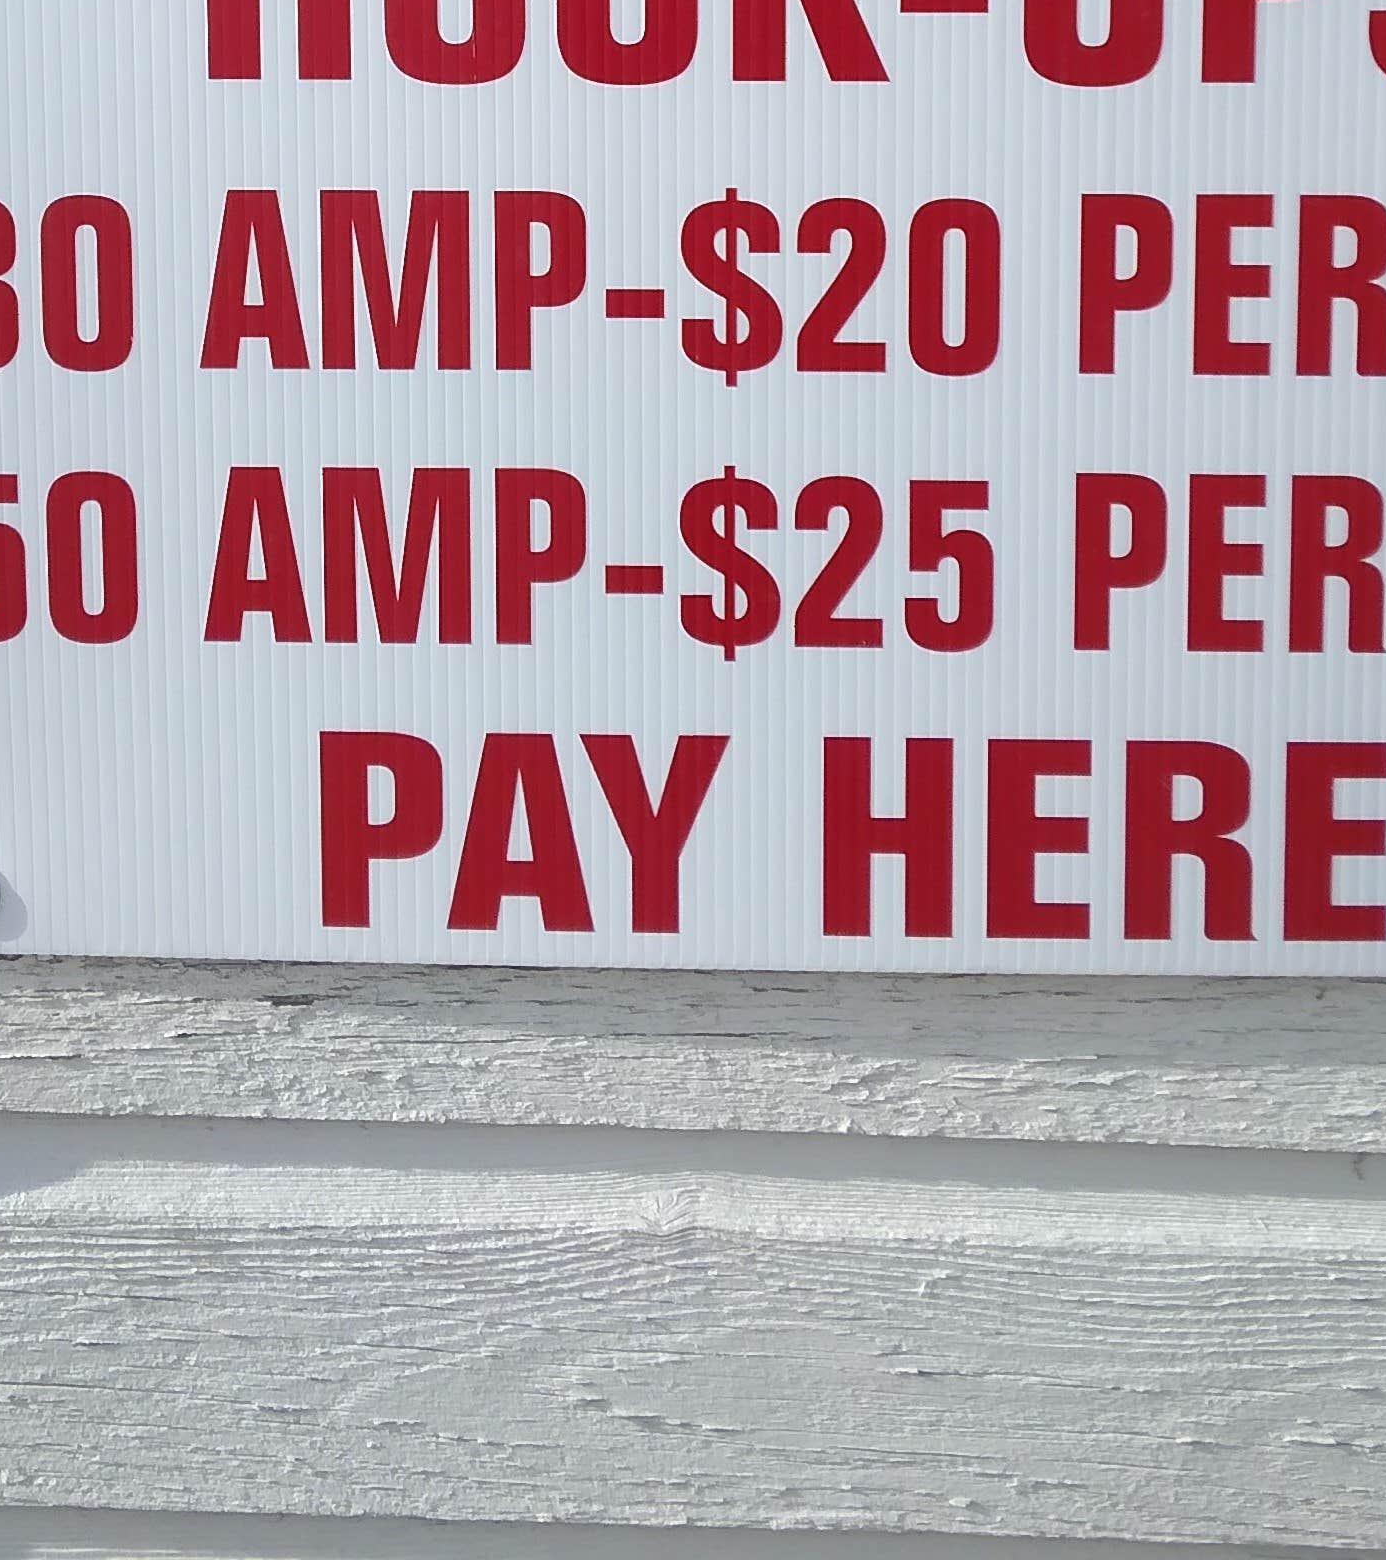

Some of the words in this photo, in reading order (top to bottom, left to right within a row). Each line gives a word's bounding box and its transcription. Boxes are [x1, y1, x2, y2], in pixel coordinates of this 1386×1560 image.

[200, 187, 1002, 386] AMP-$20
[205, 465, 994, 659] AMP-$25
[1074, 473, 1384, 654] PER
[319, 731, 729, 933] PAY
